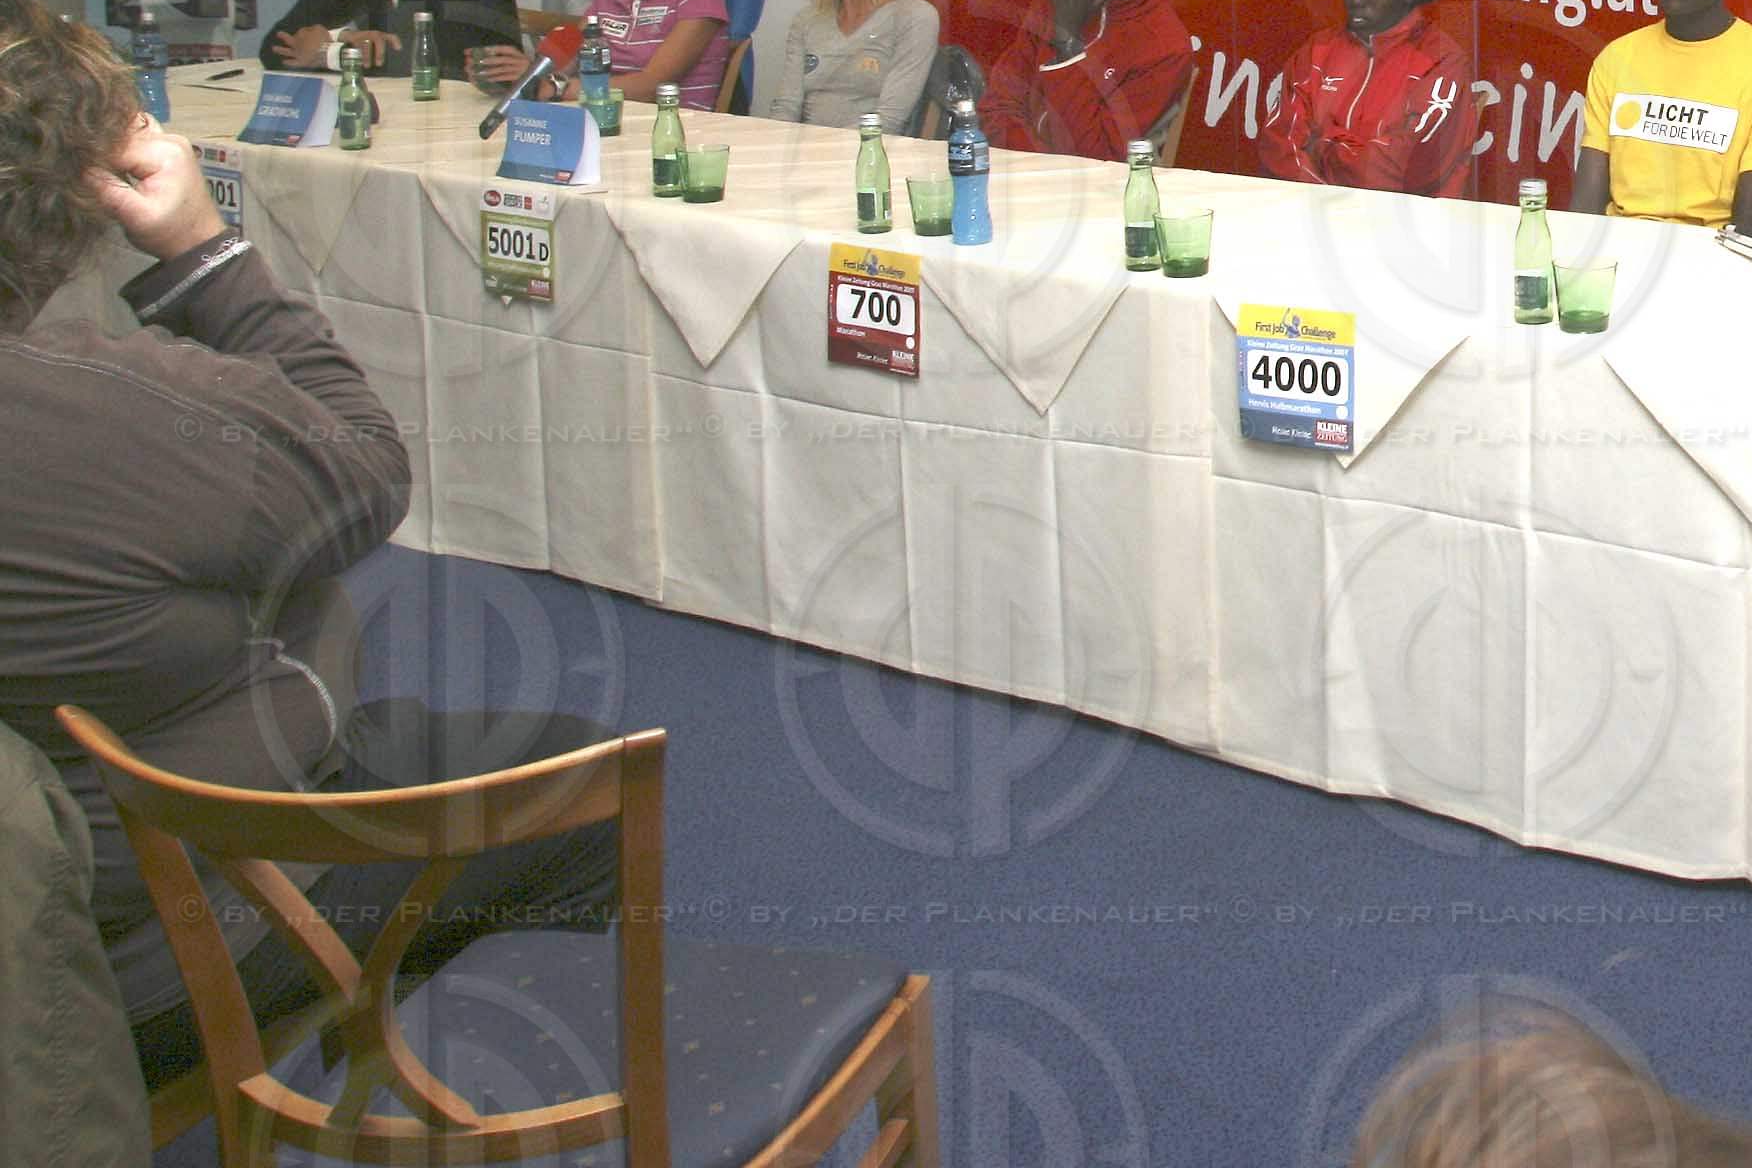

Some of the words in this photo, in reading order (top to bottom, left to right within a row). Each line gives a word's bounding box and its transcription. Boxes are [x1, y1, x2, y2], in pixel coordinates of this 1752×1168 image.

[1645, 101, 1709, 125] LICHT
[1670, 126, 1689, 140] DIE
[1692, 128, 1728, 147] WELT
[850, 288, 901, 326] 700
[1256, 322, 1272, 333] First
[1272, 324, 1285, 335] Job
[1301, 325, 1336, 340] Challenge
[1252, 355, 1341, 396] 4000
[1317, 422, 1347, 433] KLEINE
